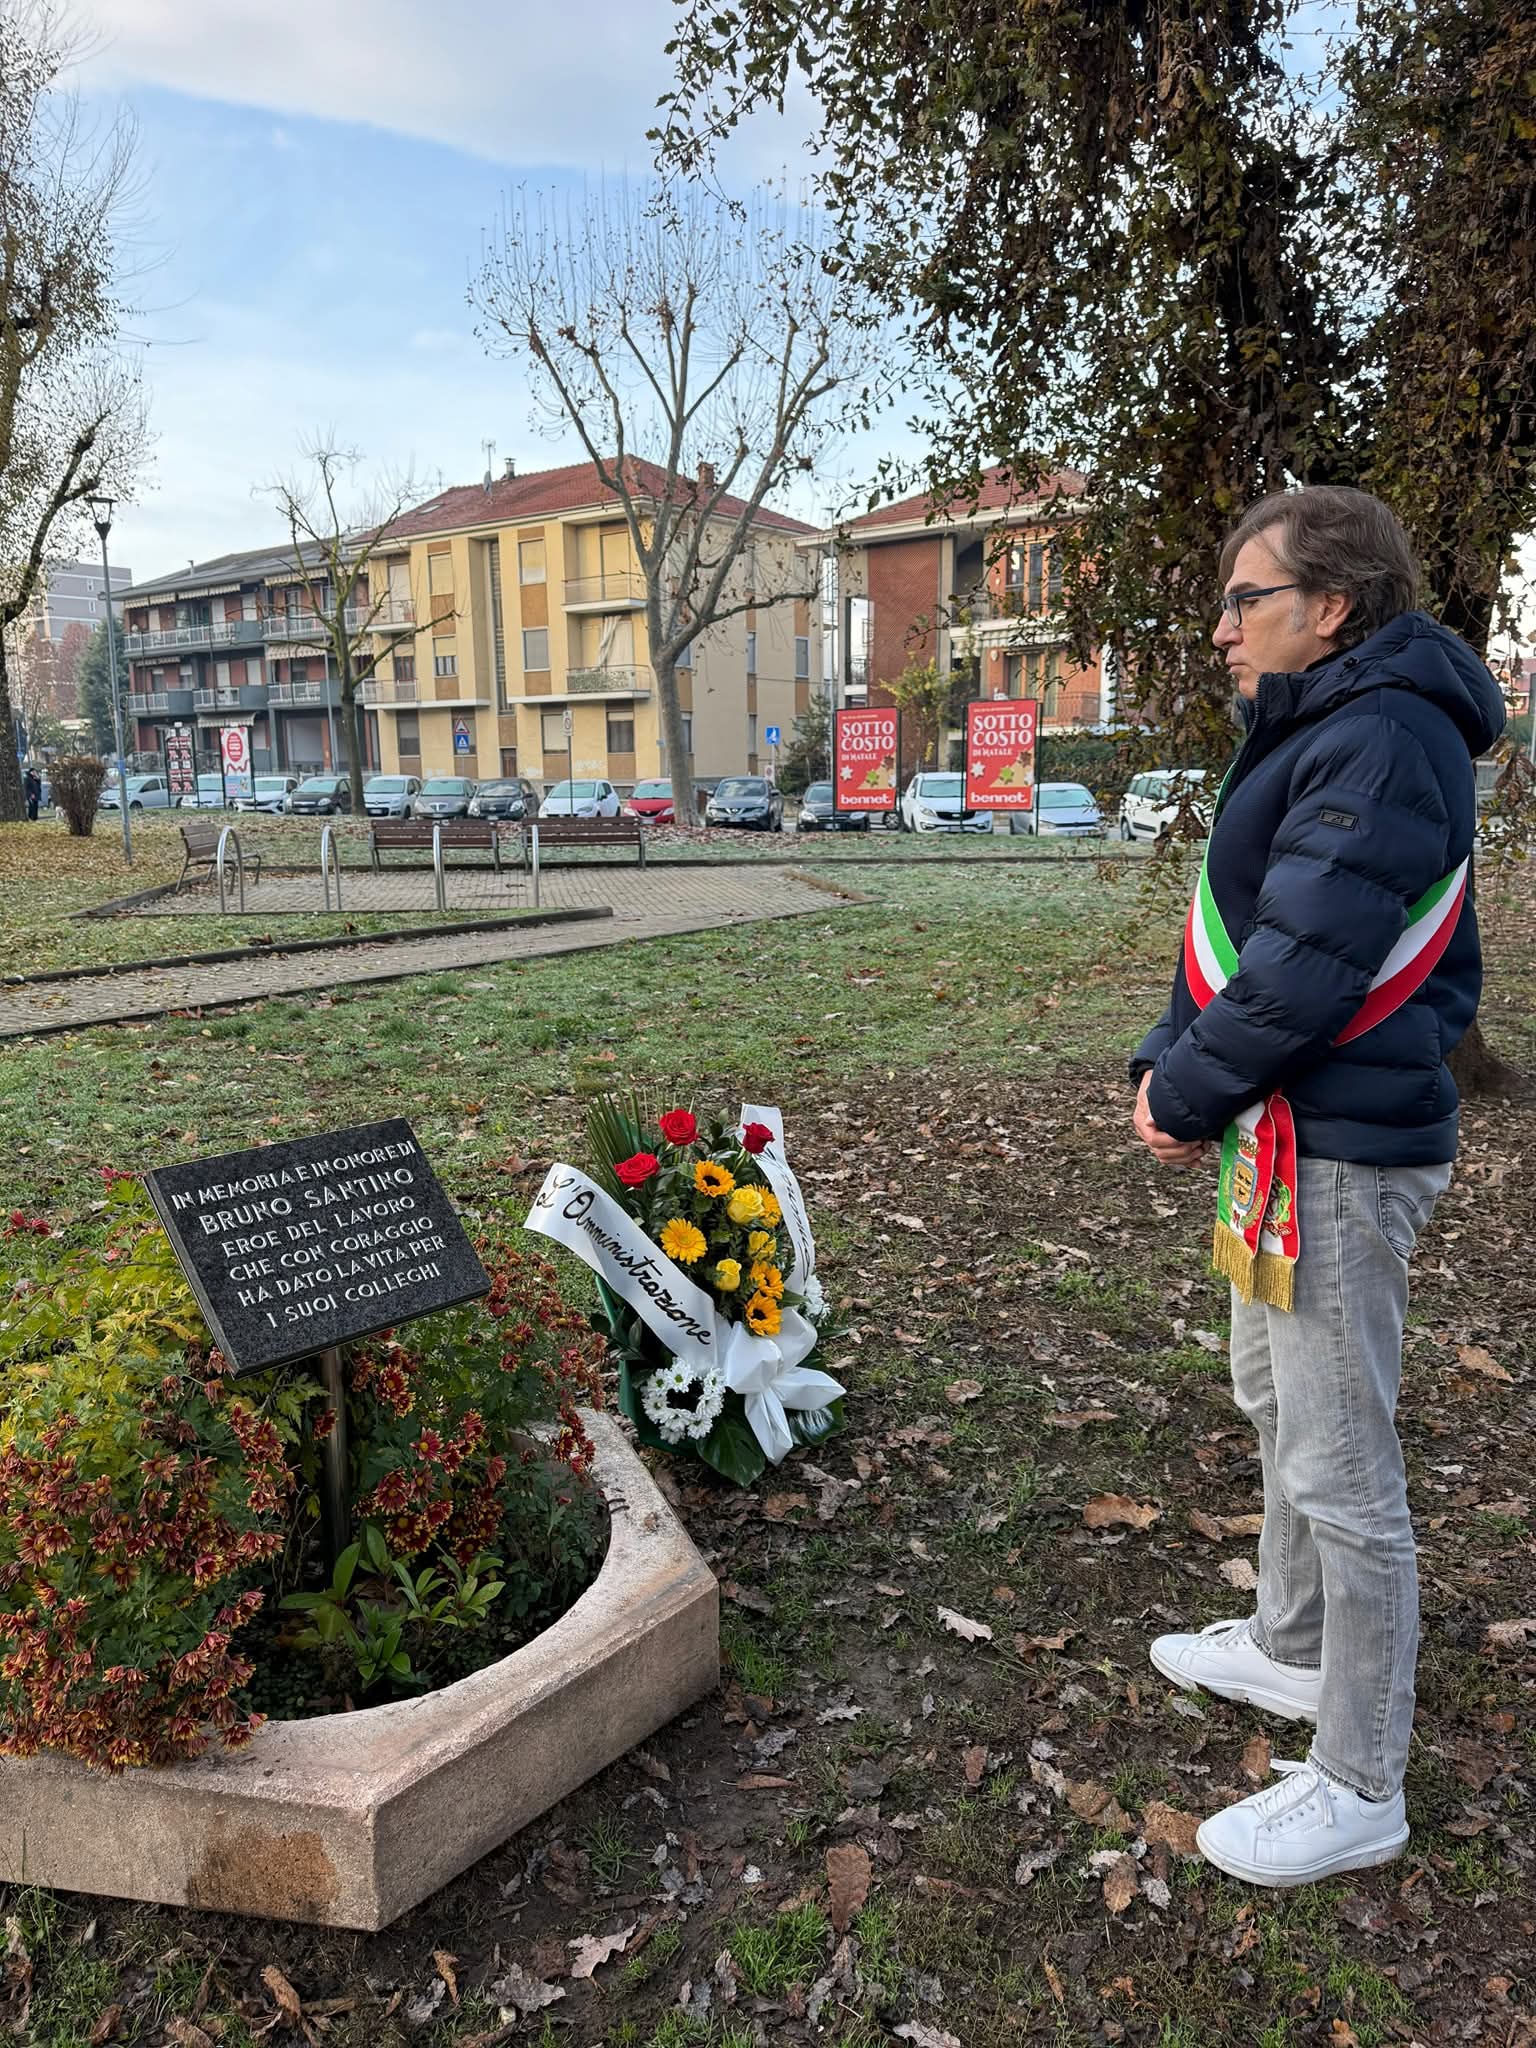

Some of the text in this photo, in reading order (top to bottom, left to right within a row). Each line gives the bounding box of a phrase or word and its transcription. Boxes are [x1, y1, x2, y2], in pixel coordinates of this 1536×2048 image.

[841, 735, 894, 752] COSTO
[842, 720, 895, 738] SOTTO
[972, 730, 1032, 747] COSTO
[973, 713, 1033, 731] SOTTO
[198, 1168, 295, 1206] MEMORIA
[333, 1145, 399, 1171] ONORE
[397, 1140, 416, 1156] DI
[199, 1168, 414, 1235] BRUNO SANTINO
[221, 1195, 416, 1258] EROE DEL LAVORO
[229, 1216, 434, 1282] CHE CON CORAGGIO
[237, 1235, 447, 1308] HA DATO LA VITA PER
[266, 1262, 441, 1329] I SUOI COLLEGHI
